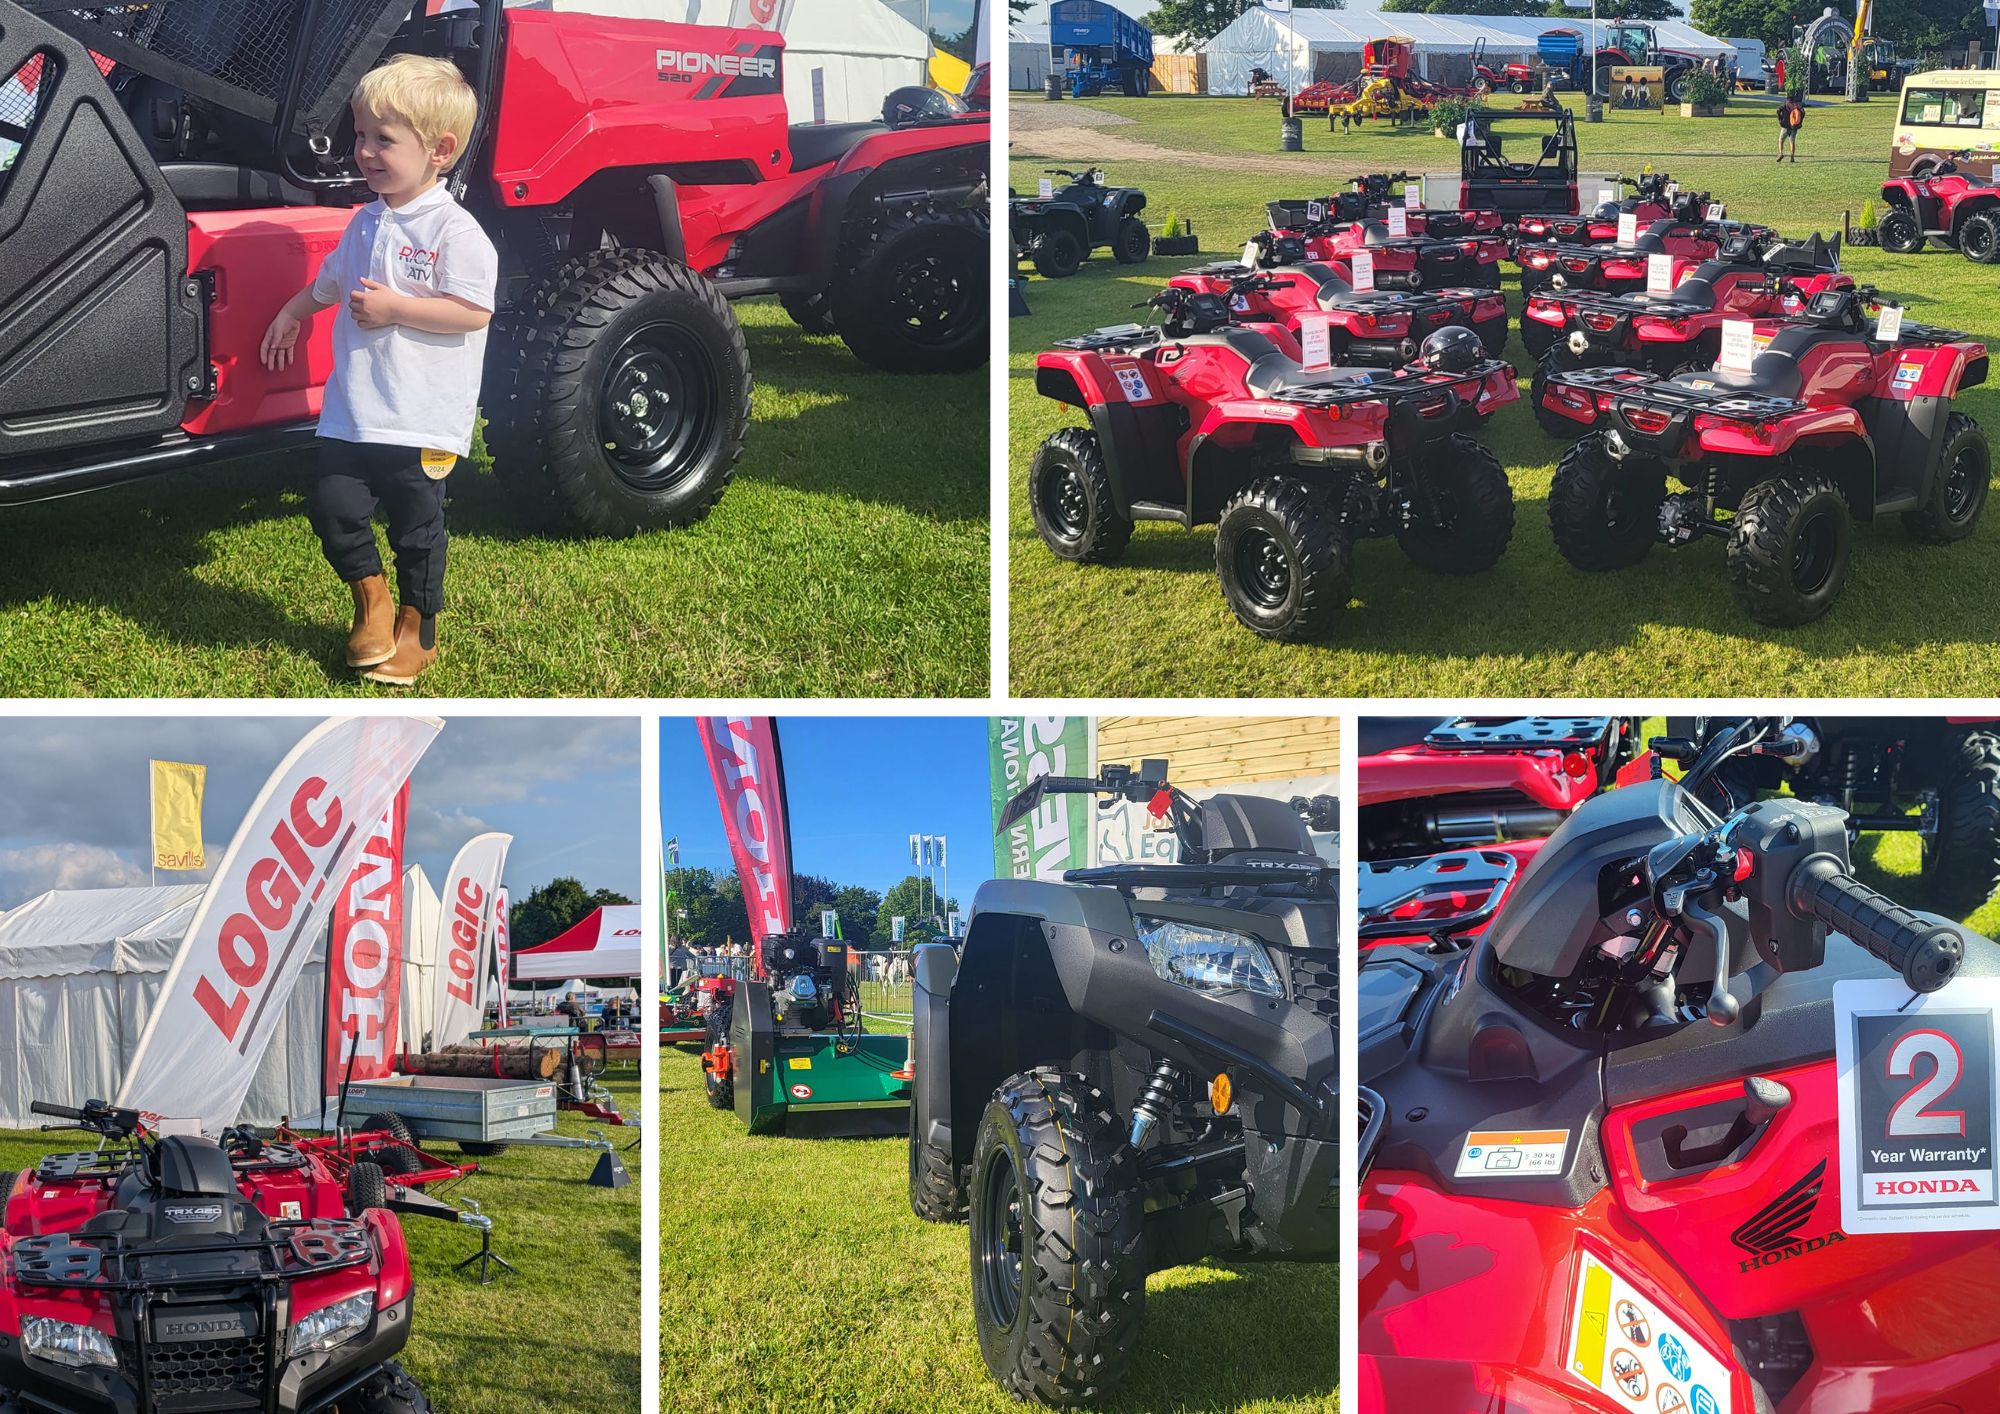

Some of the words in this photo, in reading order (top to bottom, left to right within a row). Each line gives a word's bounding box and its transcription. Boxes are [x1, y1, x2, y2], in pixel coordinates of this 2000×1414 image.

[656, 50, 776, 78] PIONEER
[658, 73, 692, 83] 520
[407, 267, 432, 282] ATV
[158, 851, 203, 867] savills
[193, 776, 343, 1043] LOGIC
[447, 877, 483, 1007] LOGIC
[1886, 1028, 1966, 1139] 2
[1529, 1159, 1542, 1167] (66
[1544, 1159, 1556, 1167] lb)
[1545, 1152, 1556, 1160] kg
[1871, 1150, 1906, 1163] Year
[1876, 1179, 1980, 1195] HONDA
[1738, 1231, 1847, 1273] HONDA
[166, 1320, 246, 1336] HONDA
